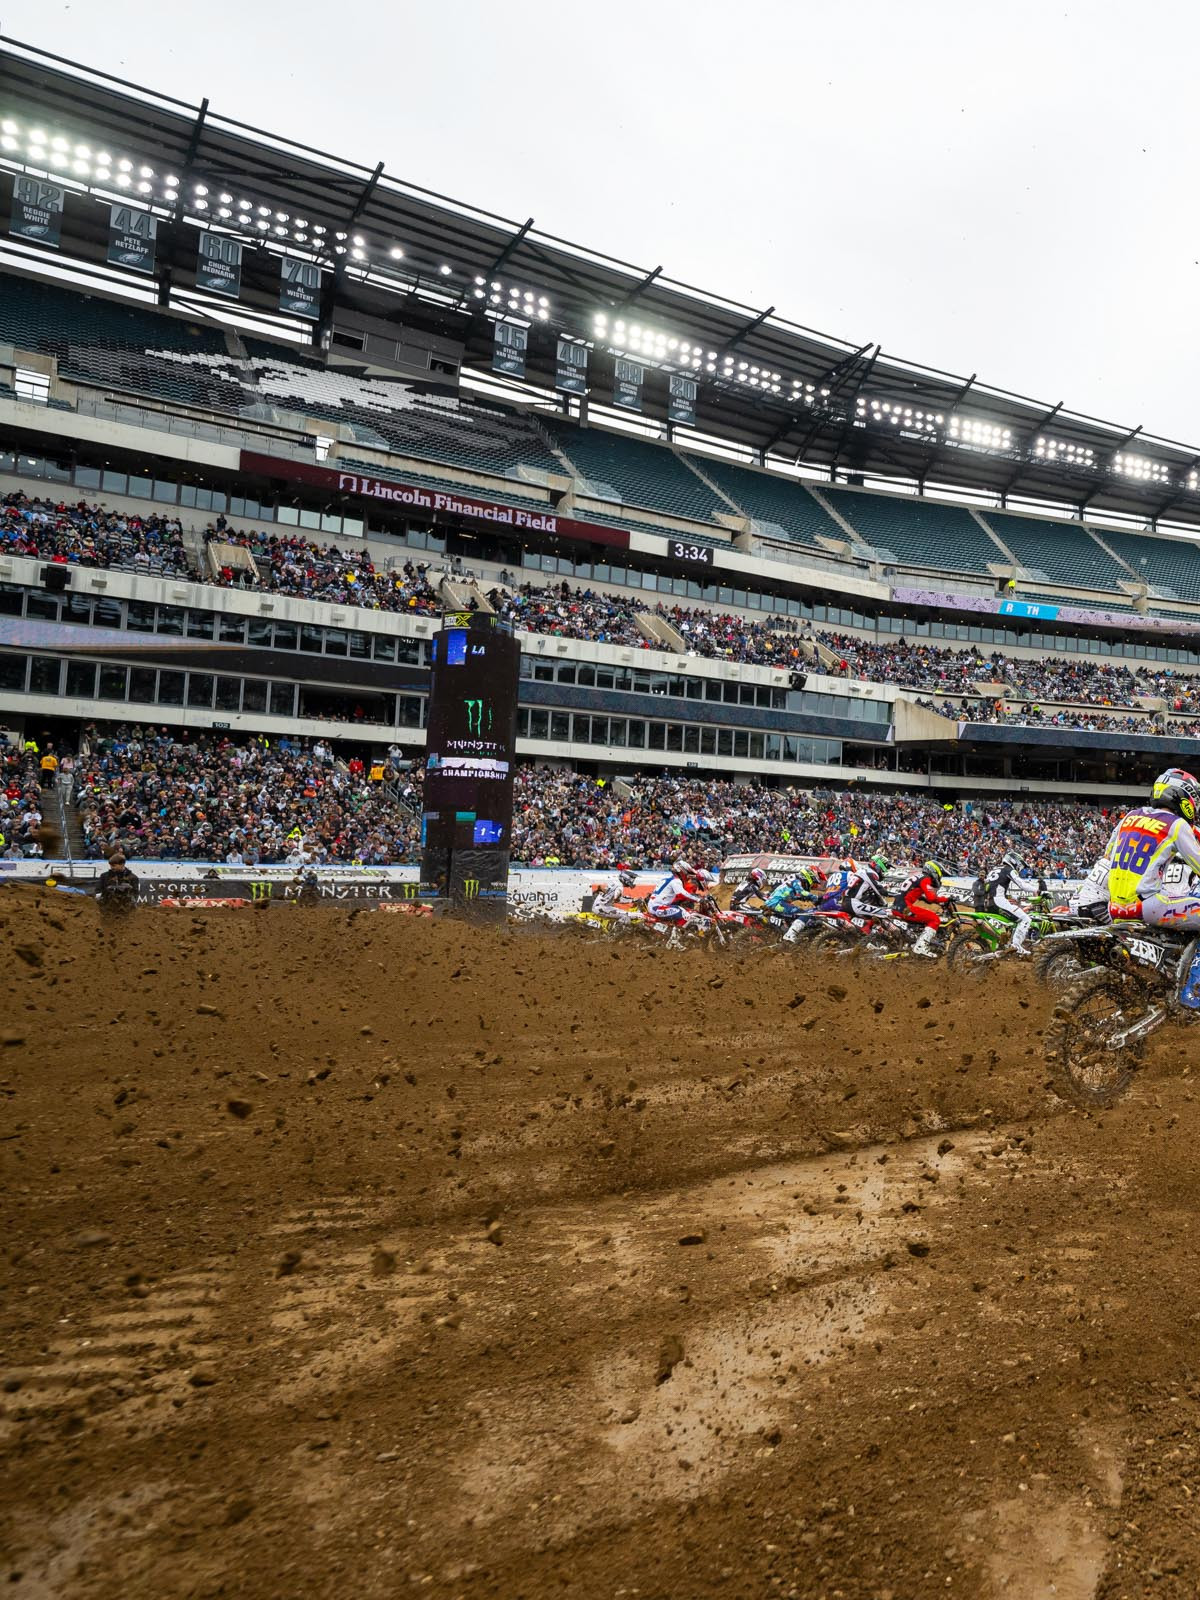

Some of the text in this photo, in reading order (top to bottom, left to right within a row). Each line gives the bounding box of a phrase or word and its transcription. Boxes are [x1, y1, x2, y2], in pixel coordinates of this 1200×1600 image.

[18, 178, 60, 213] 92
[24, 213, 48, 225] WHITE
[114, 209, 152, 240] 44
[115, 240, 149, 254] RETZLAFF
[124, 236, 141, 246] PETE
[203, 234, 240, 265] 60
[202, 265, 235, 280] BEDNARIK
[208, 260, 231, 272] CHUCK
[285, 260, 319, 288] 70
[297, 286, 305, 294] AL
[498, 325, 525, 350] 15
[560, 343, 585, 368] 40
[671, 377, 694, 400] 20
[361, 479, 557, 533] Lincoln Financial Field
[674, 543, 708, 562] 3:34
[1122, 815, 1168, 834] STINE
[1111, 831, 1157, 875] 268
[285, 882, 393, 899] MNSTER
[1130, 940, 1157, 963] 268
